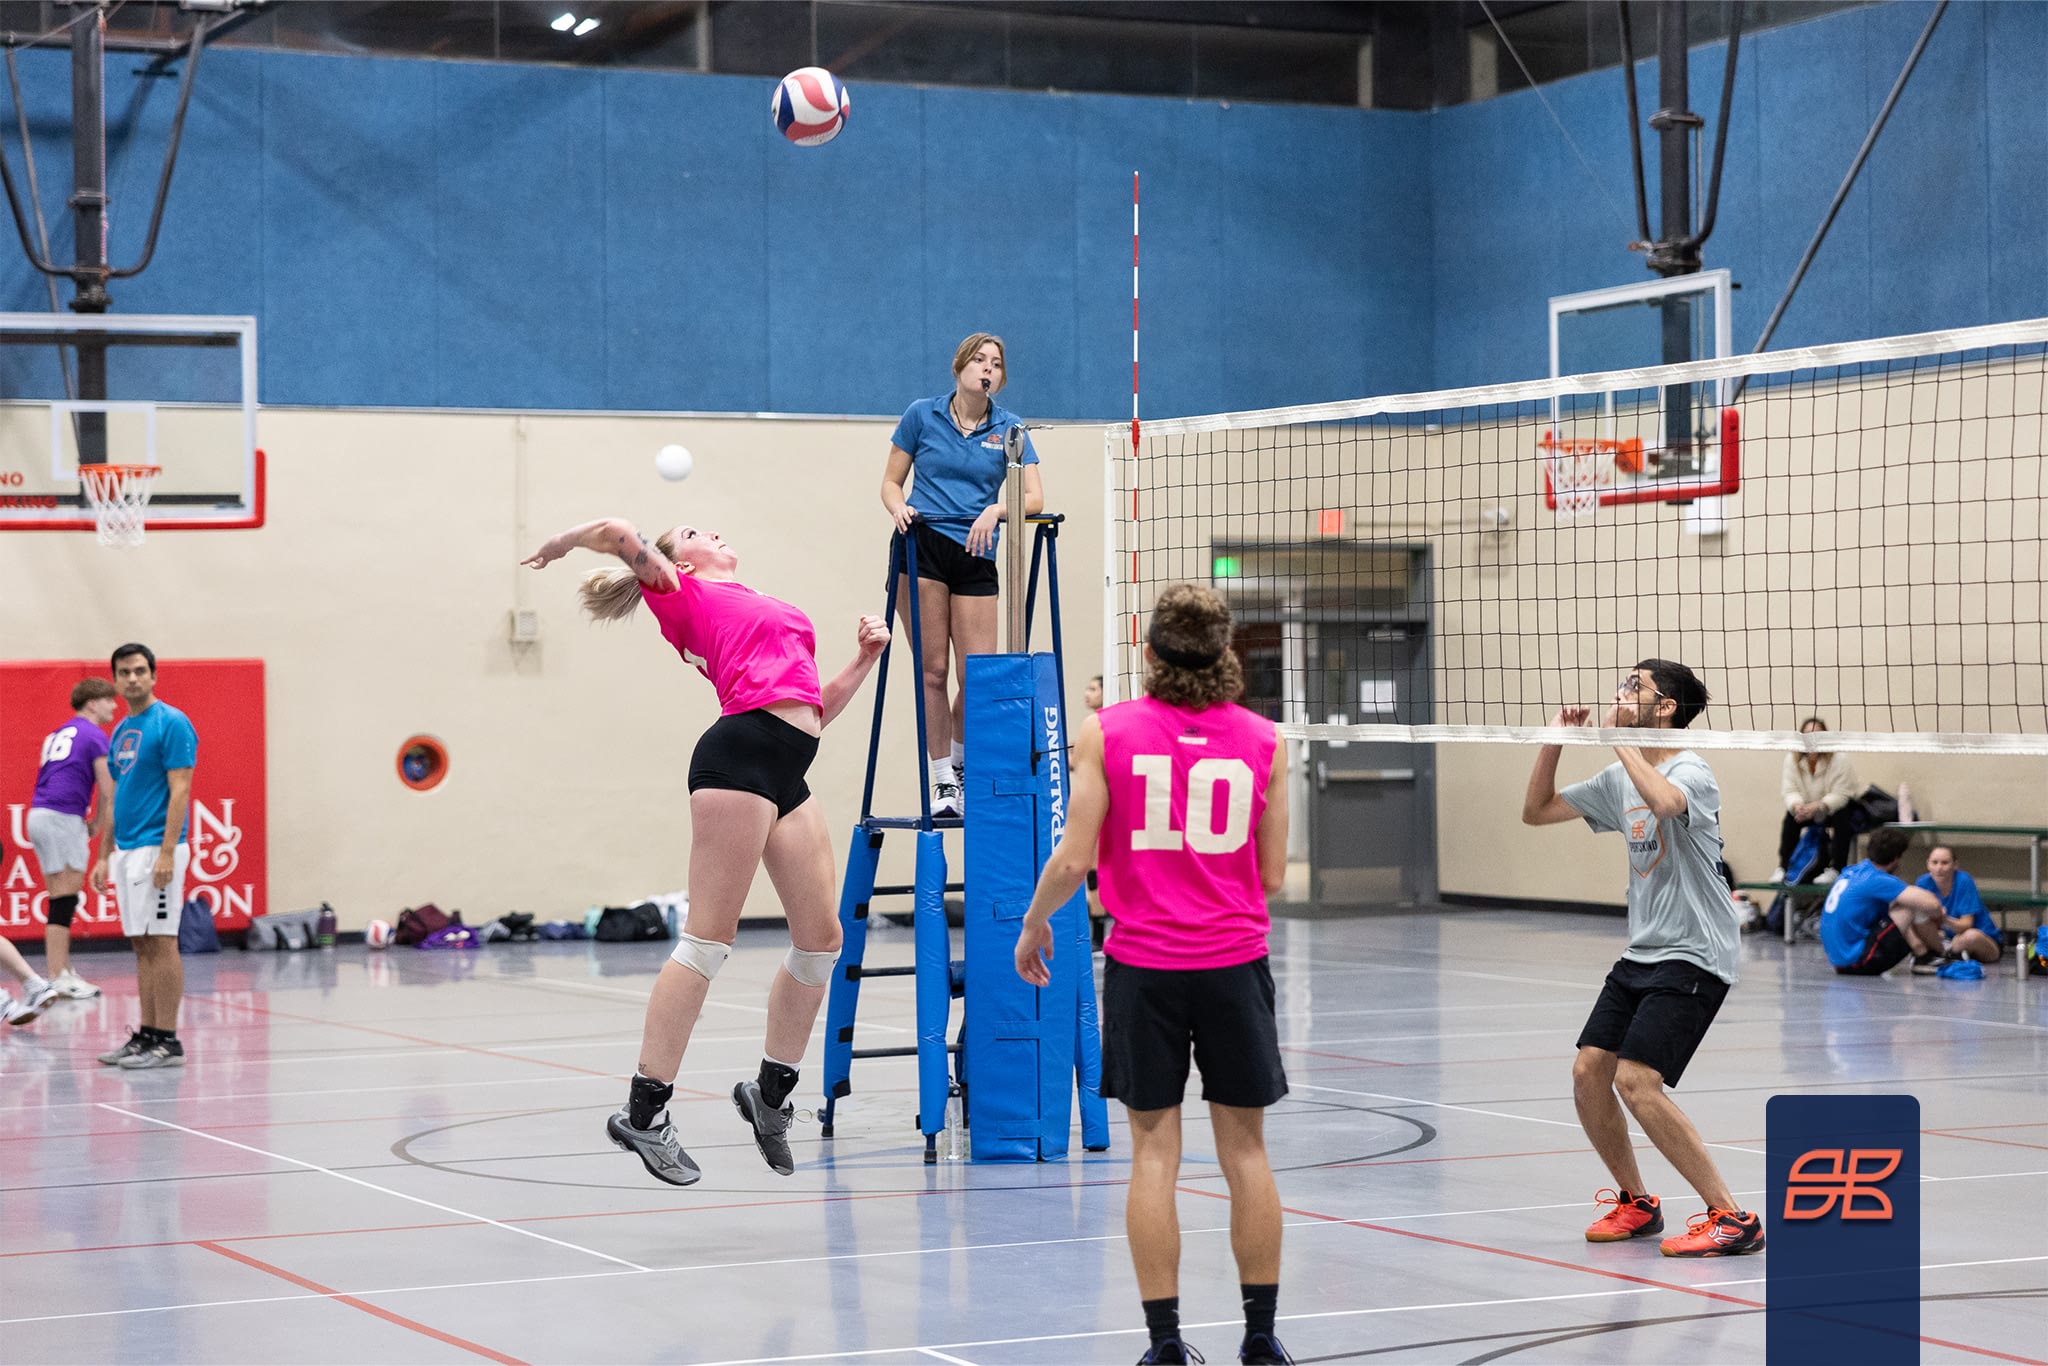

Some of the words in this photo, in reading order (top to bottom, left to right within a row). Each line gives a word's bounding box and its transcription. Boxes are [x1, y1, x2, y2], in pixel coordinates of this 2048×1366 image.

[0, 495, 57, 509] KING
[1044, 704, 1065, 855] PALDING
[1131, 754, 1254, 854] 10
[1825, 878, 1849, 914] 8
